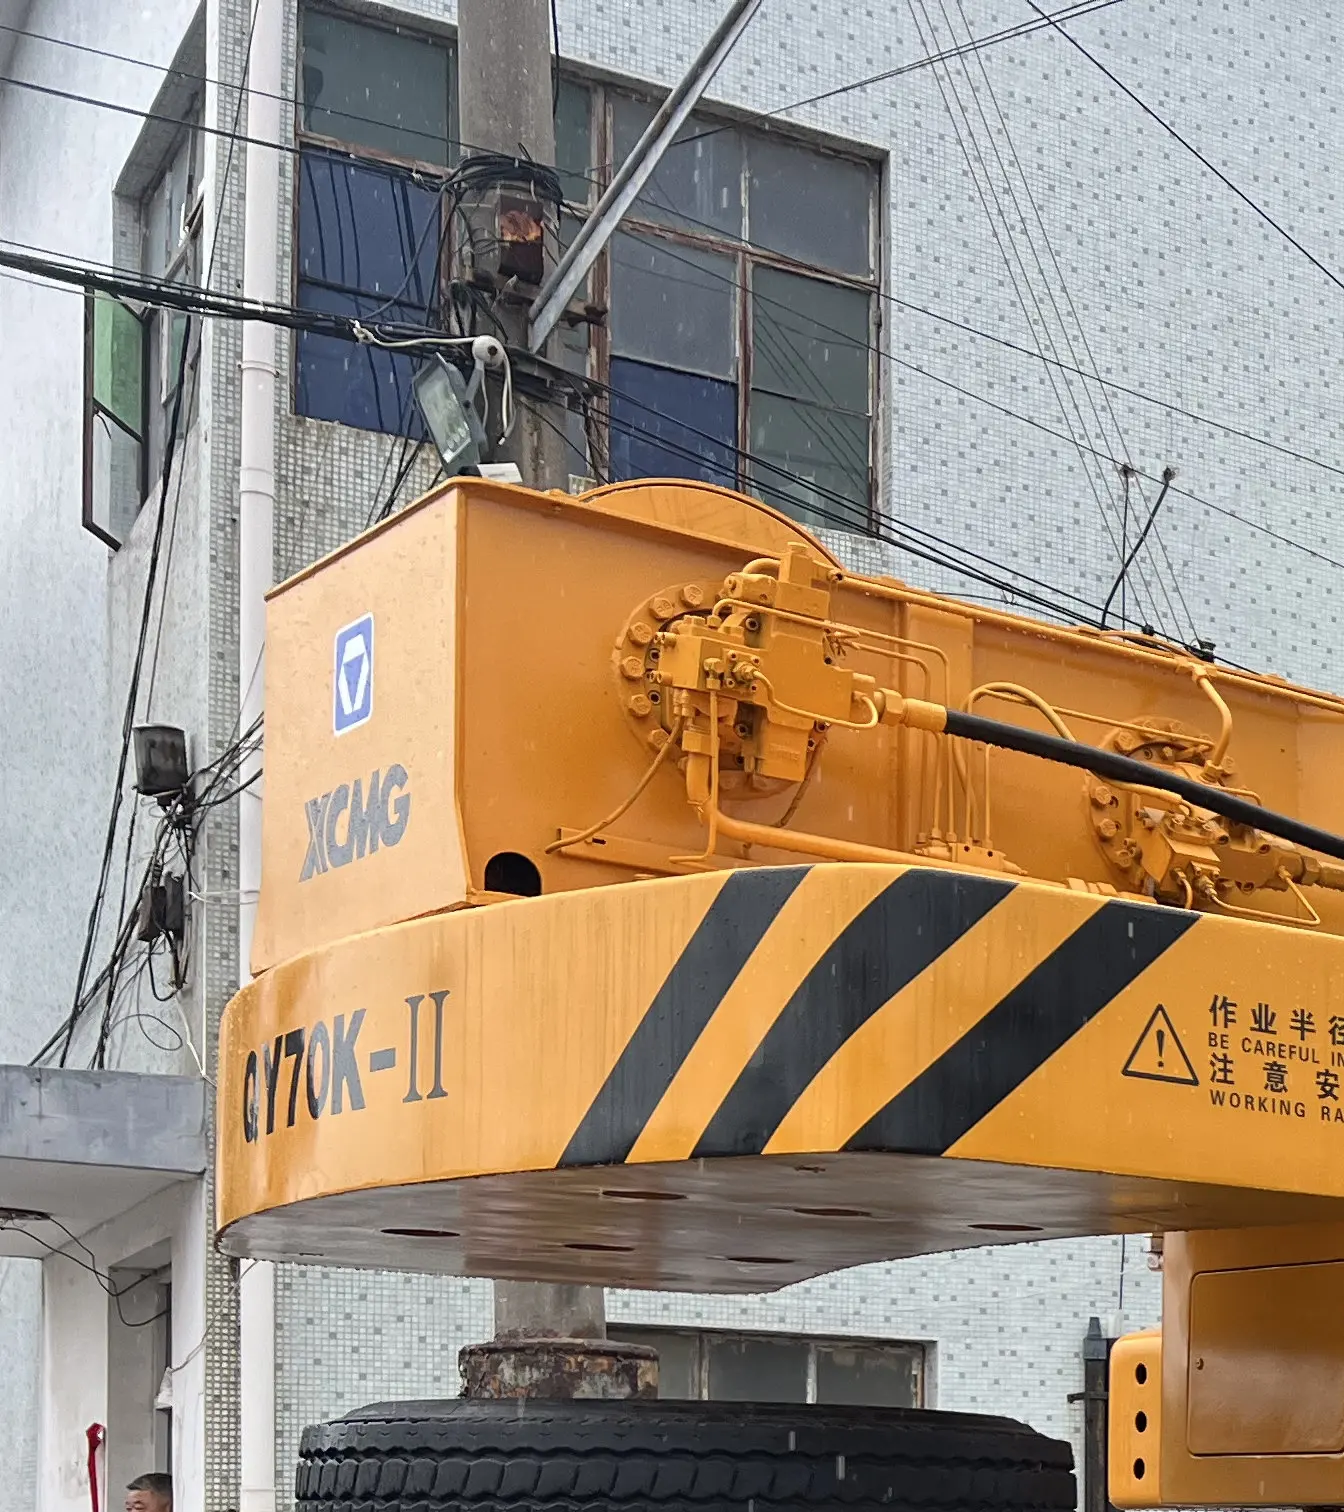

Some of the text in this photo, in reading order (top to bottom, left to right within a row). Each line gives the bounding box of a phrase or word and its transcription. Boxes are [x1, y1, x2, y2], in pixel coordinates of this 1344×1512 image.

[298, 763, 411, 883] XCMG
[1208, 1032, 1230, 1050] BE
[1241, 1037, 1321, 1065] CAREFUL
[1209, 1089, 1306, 1118] WORKING
